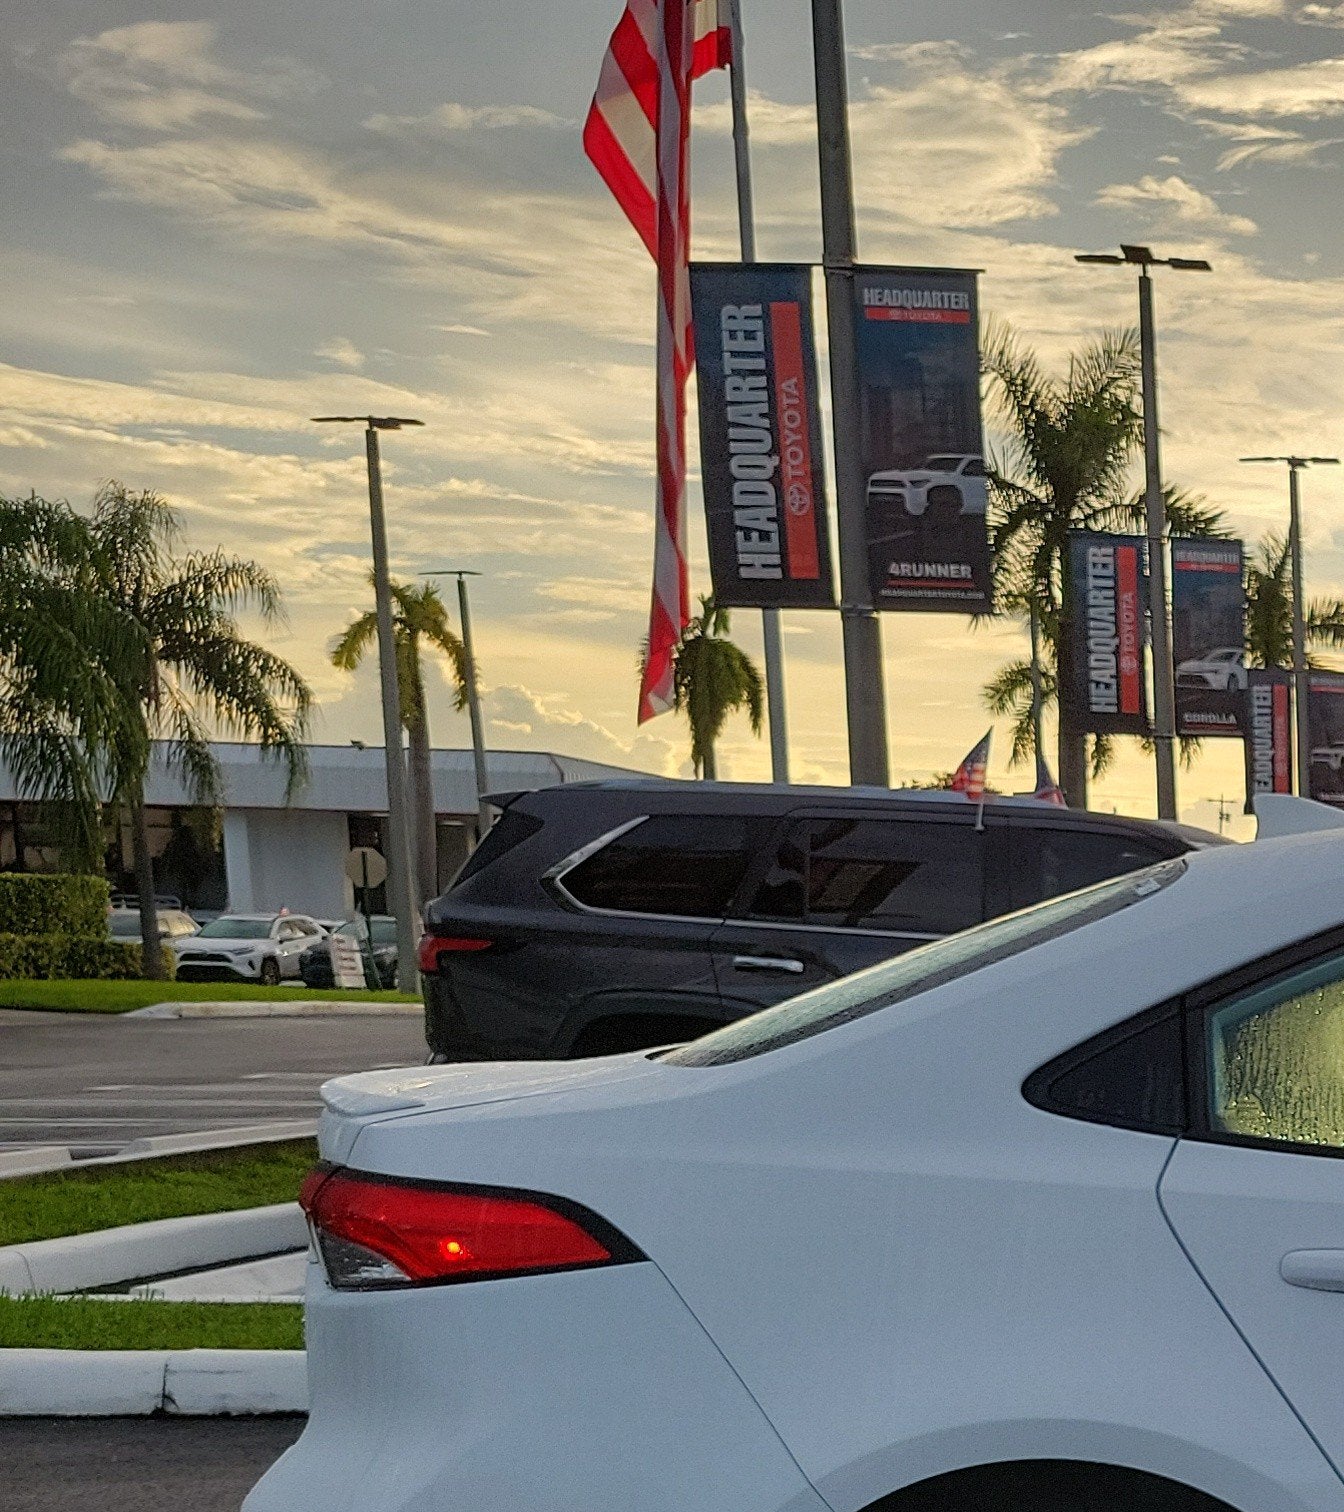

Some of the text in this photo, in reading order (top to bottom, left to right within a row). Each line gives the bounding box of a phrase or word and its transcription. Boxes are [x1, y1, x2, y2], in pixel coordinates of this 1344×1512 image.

[863, 287, 970, 311] HEADQUARTER
[720, 302, 783, 580] HEADQUARTER
[782, 377, 806, 479] TOYOTA
[888, 561, 973, 580] 4RUNNER
[1087, 547, 1119, 714] HEADQUARTER
